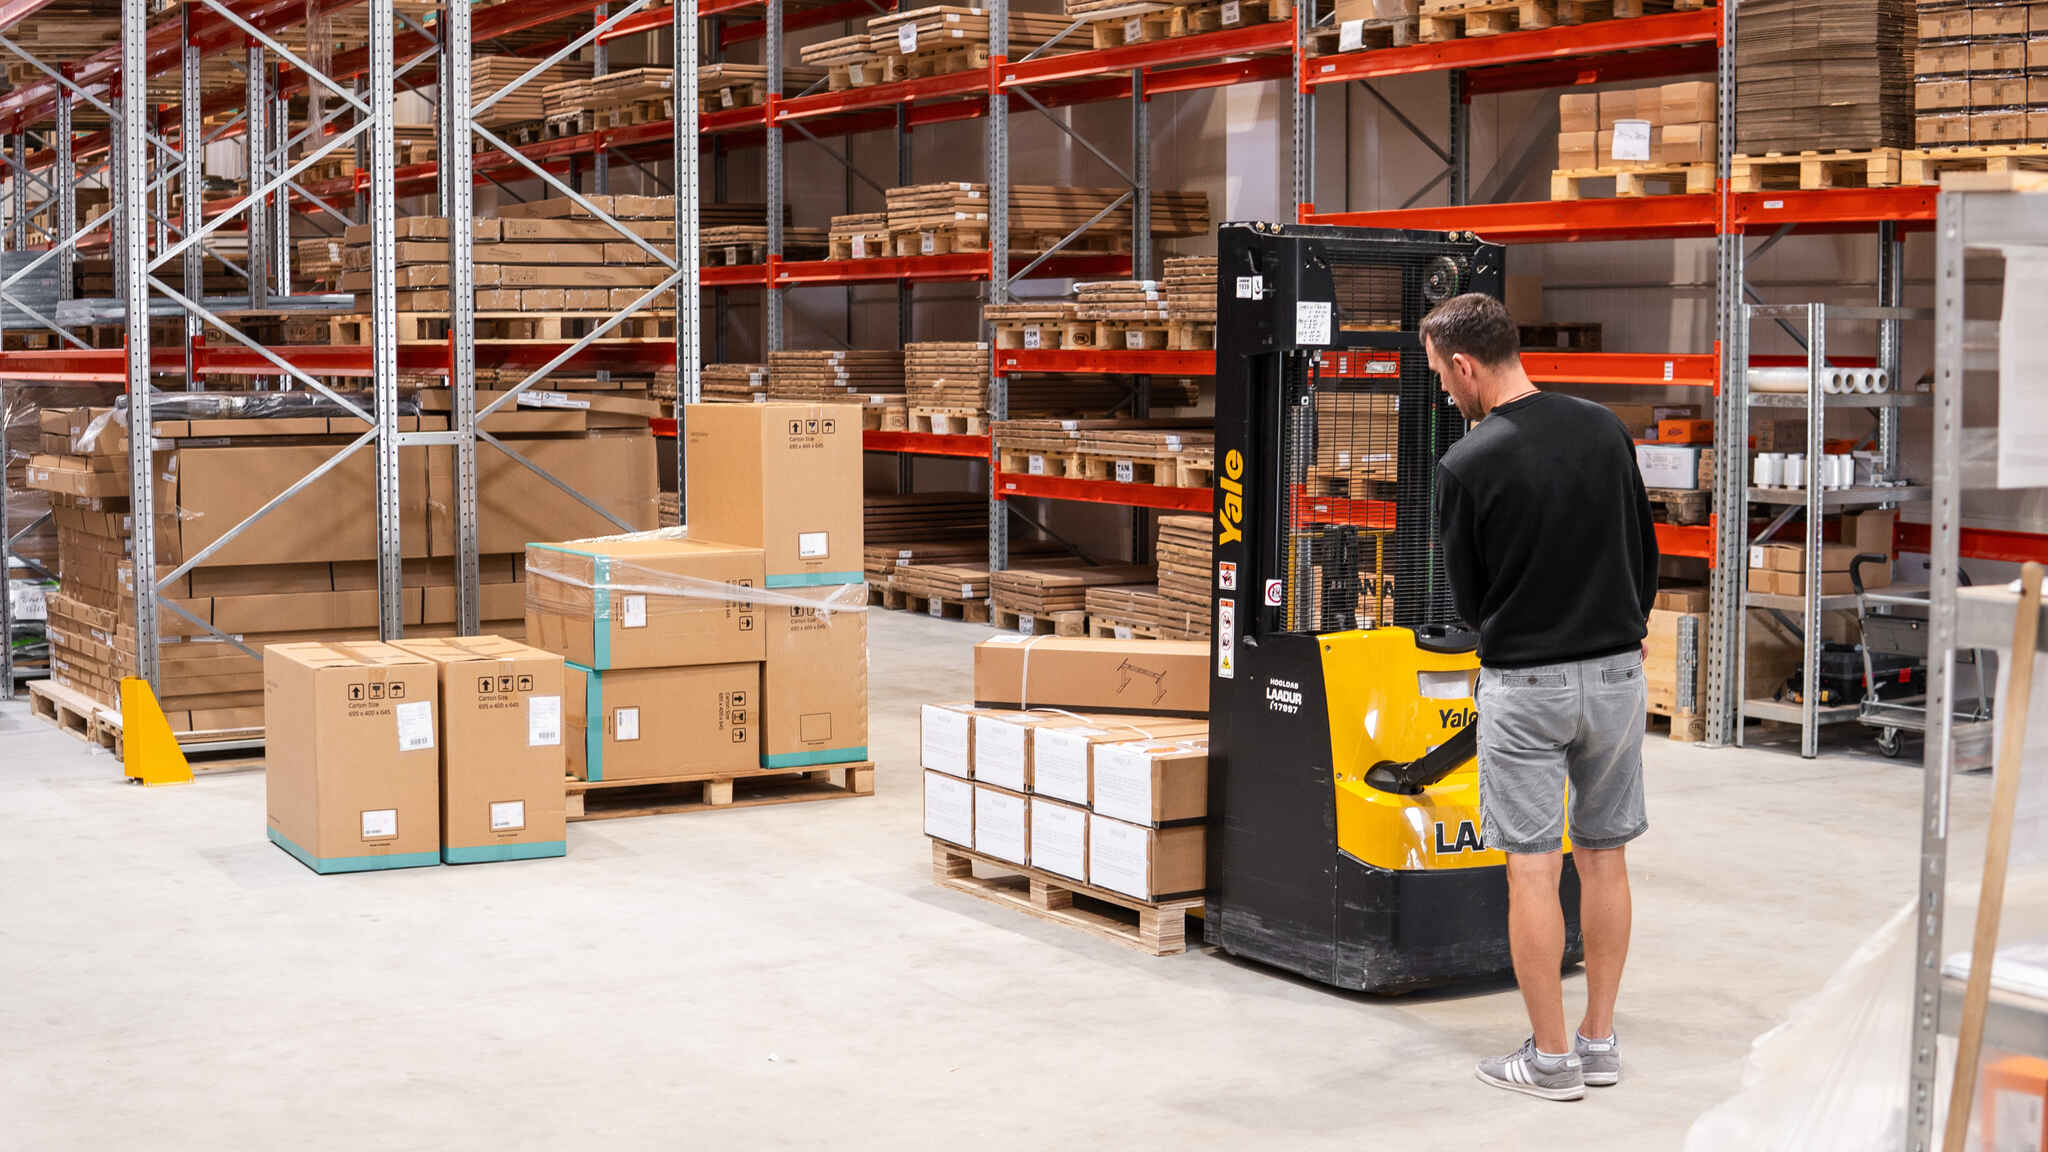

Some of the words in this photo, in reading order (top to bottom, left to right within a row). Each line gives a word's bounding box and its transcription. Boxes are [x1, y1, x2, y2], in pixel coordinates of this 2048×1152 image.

[1219, 449, 1244, 545] Yale
[1266, 687, 1302, 705] LAADUR
[1435, 820, 1485, 855] LA
